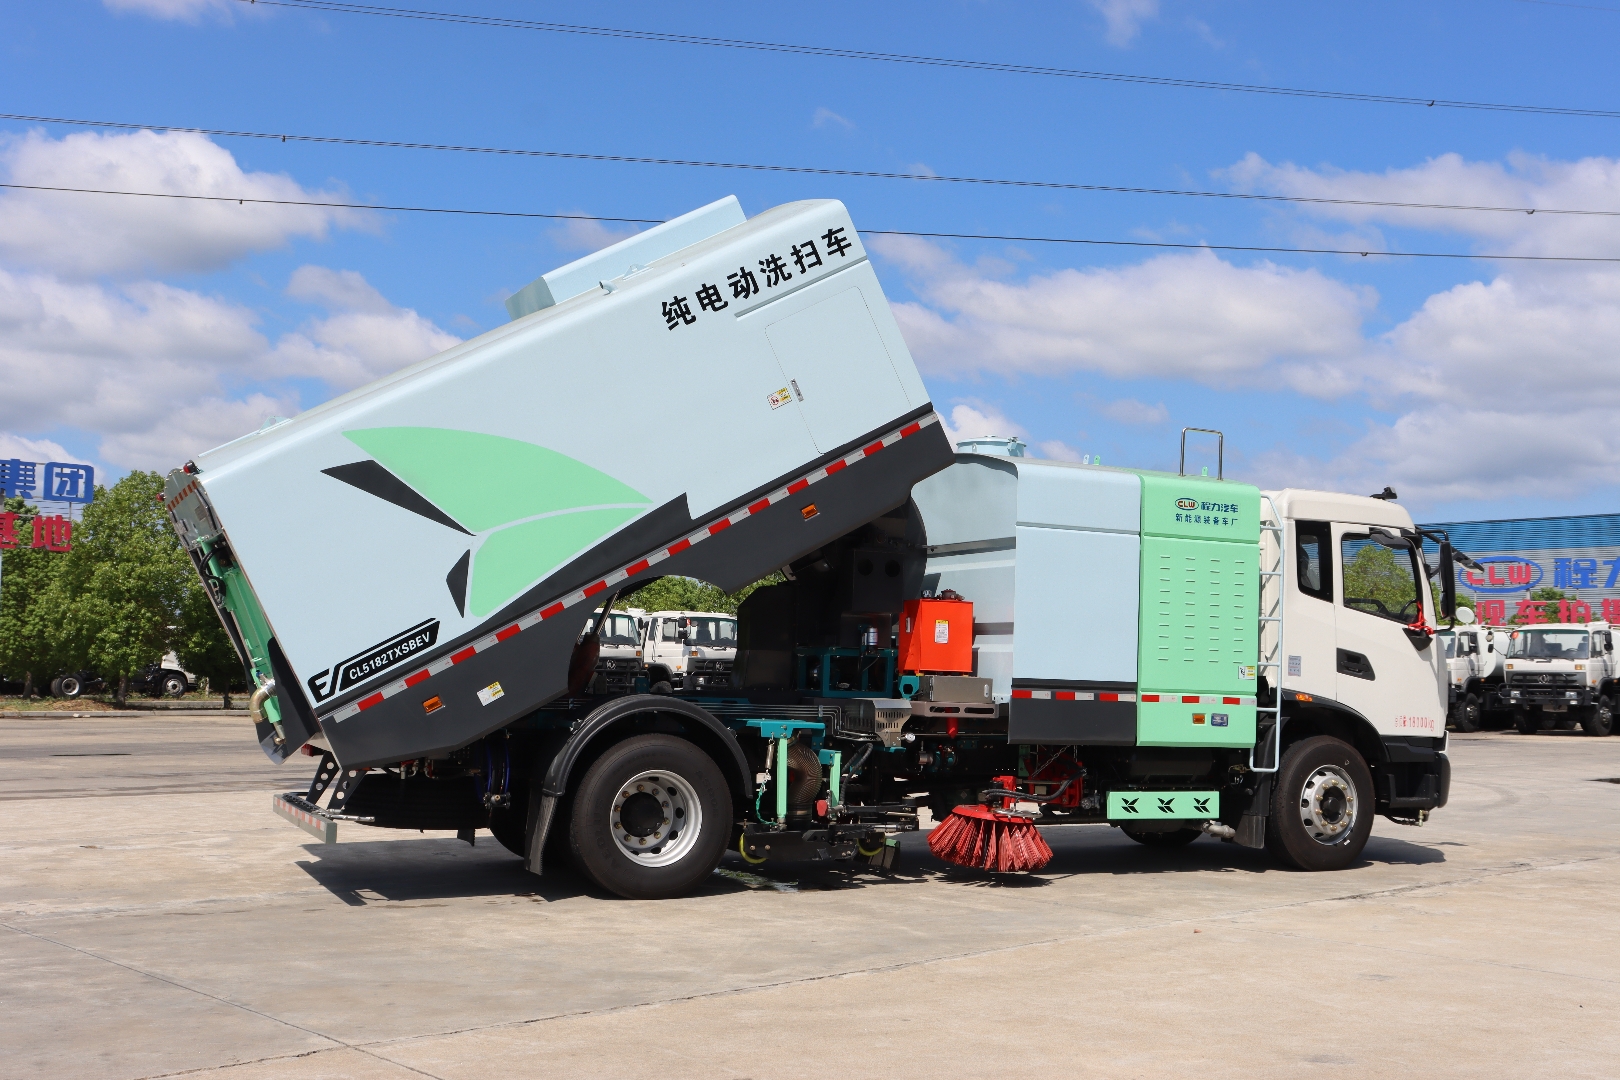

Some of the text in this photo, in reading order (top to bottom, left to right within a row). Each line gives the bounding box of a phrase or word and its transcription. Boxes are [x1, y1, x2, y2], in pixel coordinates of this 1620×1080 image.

[661, 226, 852, 331] 纯电动洗扫车
[0, 459, 94, 503] 集团
[1175, 513, 1239, 526] 新能源装备车厂
[1177, 500, 1239, 513] CLW 程力汽车
[1466, 563, 1531, 585] CLW
[349, 631, 431, 680] CL5182TXSBEV
